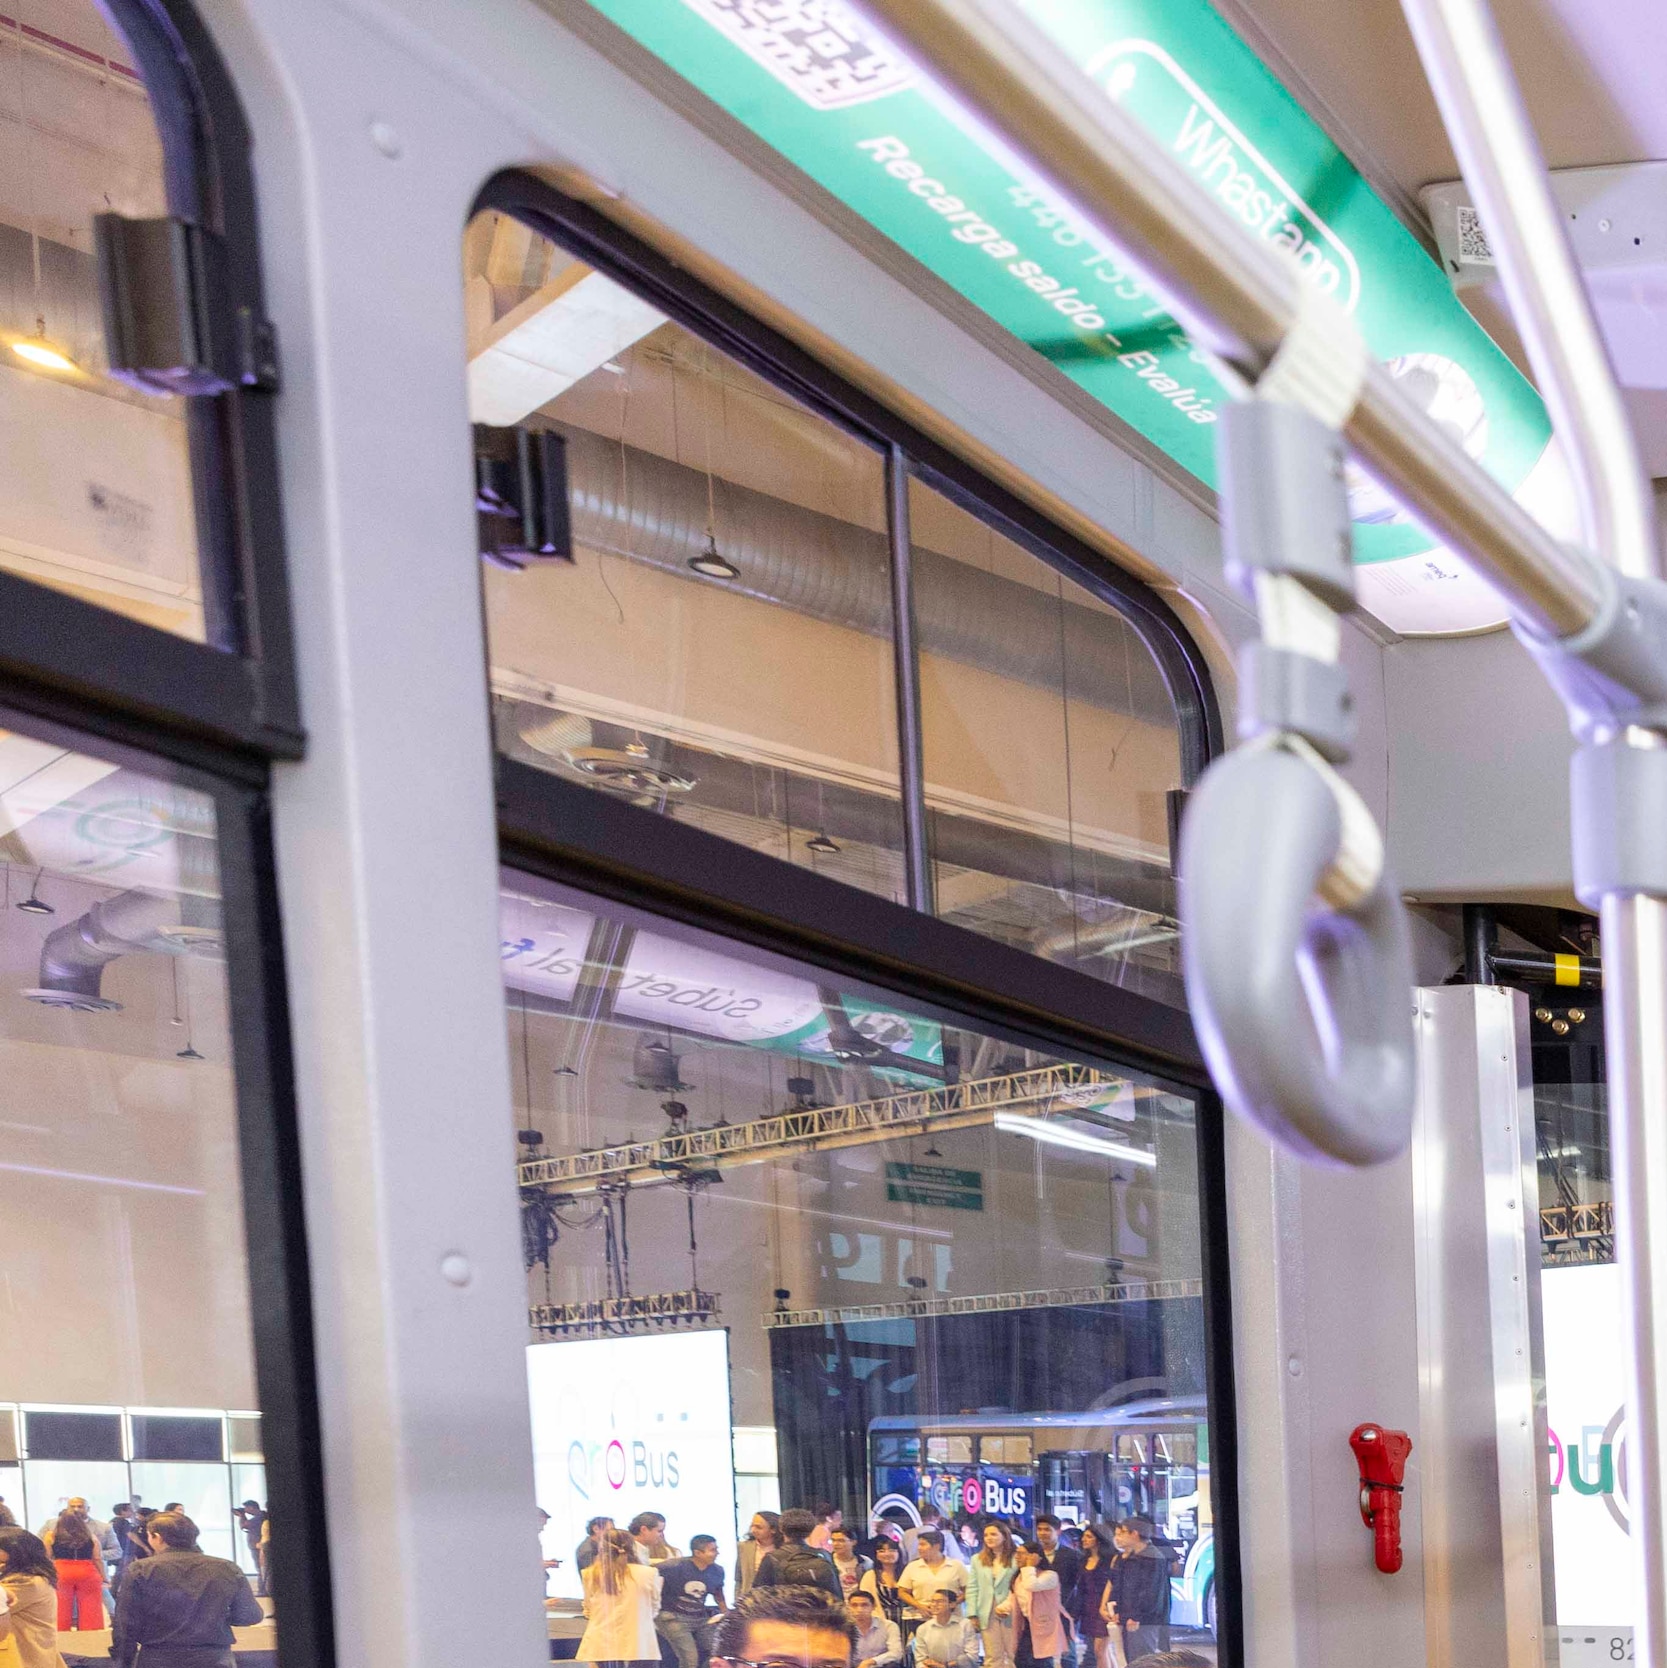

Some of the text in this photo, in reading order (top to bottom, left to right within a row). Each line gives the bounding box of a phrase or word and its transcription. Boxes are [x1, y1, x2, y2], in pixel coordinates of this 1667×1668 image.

[855, 134, 1019, 260] Recarga
[1007, 260, 1106, 330] saldo
[1116, 350, 1218, 425] Evalúa
[632, 1440, 680, 1489] Bus
[985, 1479, 1027, 1516] Bus
